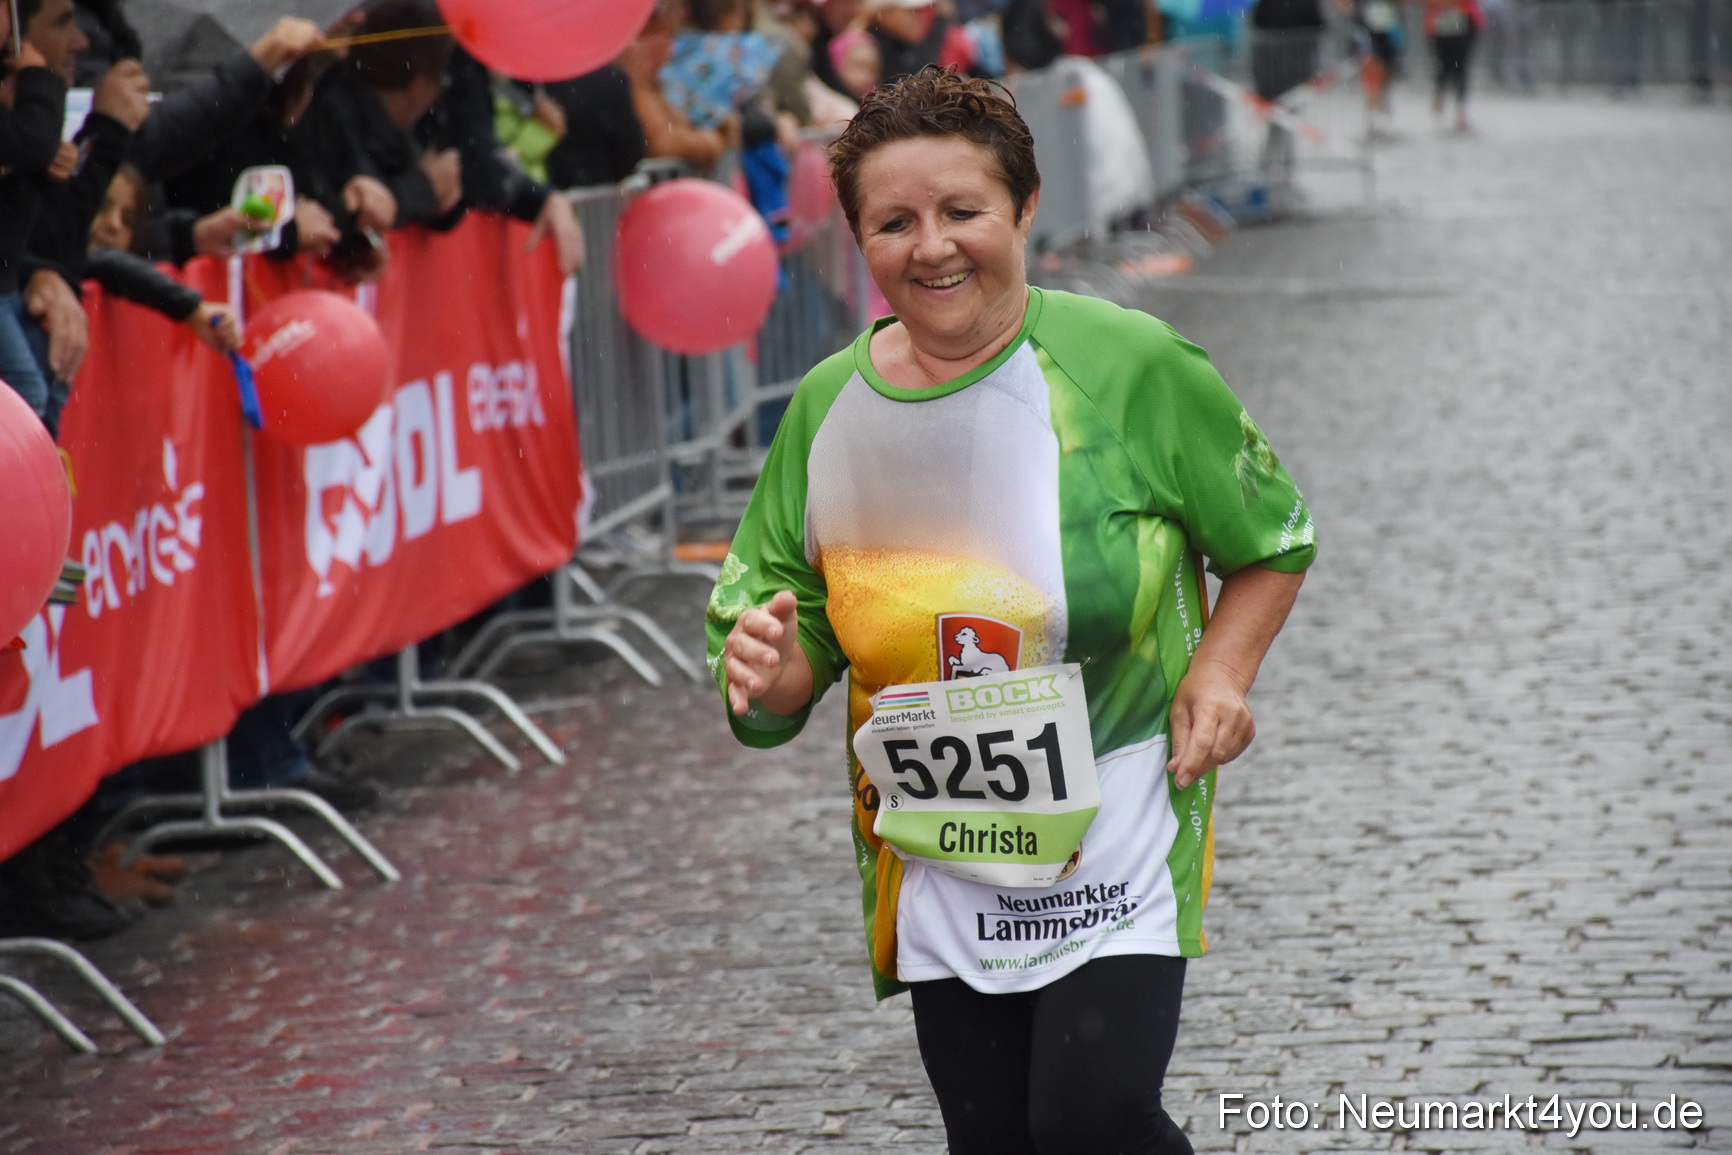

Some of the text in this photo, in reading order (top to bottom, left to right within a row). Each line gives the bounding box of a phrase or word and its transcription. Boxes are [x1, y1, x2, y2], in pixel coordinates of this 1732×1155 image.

[945, 674, 1063, 714] BOCK
[986, 710, 997, 719] by
[999, 706, 1024, 717] smart
[1026, 701, 1065, 713] concepts
[883, 722, 1068, 802] 5251
[939, 821, 1038, 856] Christa
[996, 881, 1129, 913] Neumarkter
